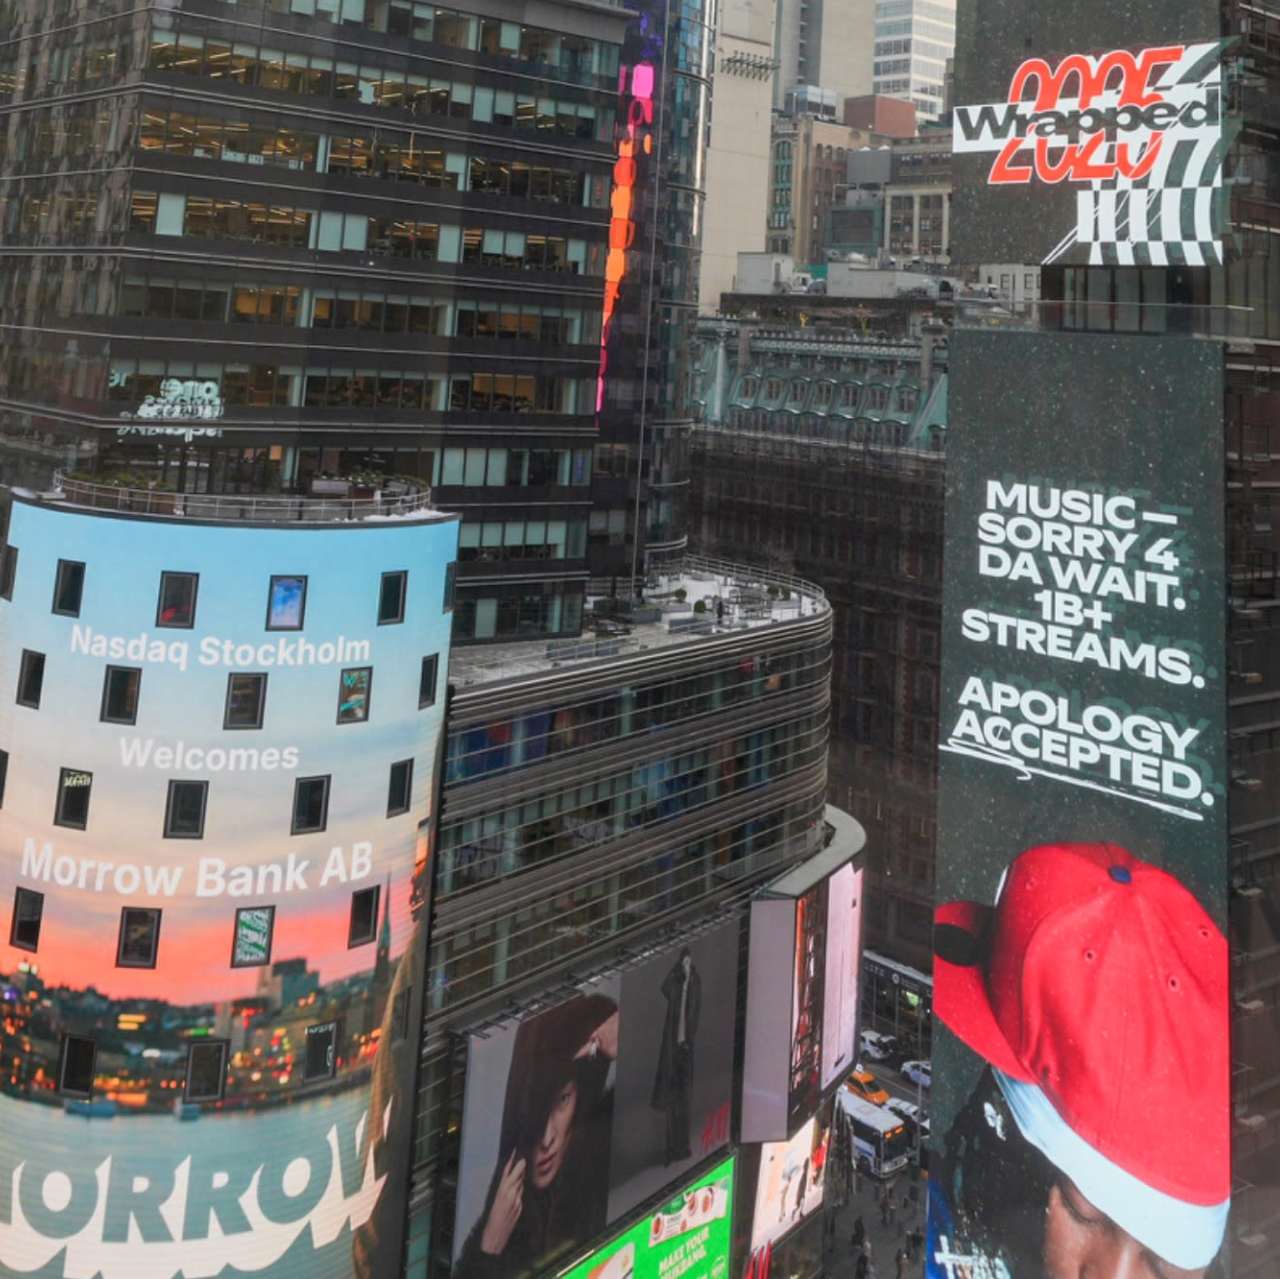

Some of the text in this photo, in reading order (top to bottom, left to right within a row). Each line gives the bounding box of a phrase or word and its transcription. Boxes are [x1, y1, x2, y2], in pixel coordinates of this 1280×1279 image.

[955, 86, 1220, 144] Wrapped
[978, 512, 1180, 571] SORRY 4
[979, 545, 1186, 610] DA WAIT.
[1034, 589, 1112, 630] 1B+
[70, 624, 370, 671] Nasdaq Stockholm
[961, 608, 1205, 689] STREAMS.
[958, 676, 1200, 760] APOLOGY
[120, 736, 300, 771] Welcomes
[951, 708, 1214, 806] ACCEPTED.
[19, 837, 373, 898] Morrow Bank AB
